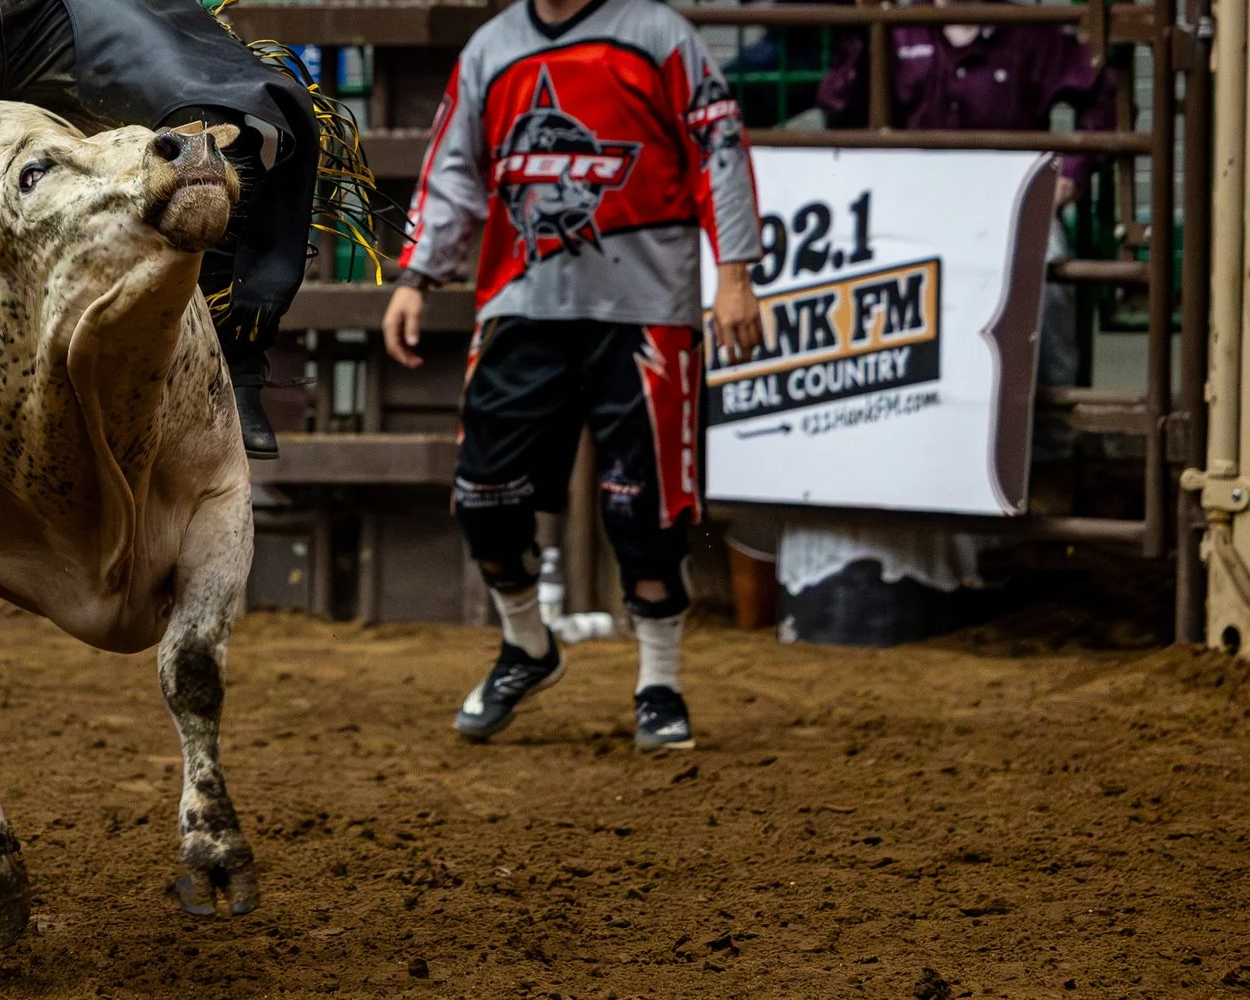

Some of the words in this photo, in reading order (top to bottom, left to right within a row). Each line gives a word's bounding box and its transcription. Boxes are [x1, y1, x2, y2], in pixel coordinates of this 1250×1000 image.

[752, 189, 874, 286] 92.1
[853, 273, 924, 341] FM
[722, 373, 782, 414] REAL
[787, 347, 910, 401] COUNTRY
